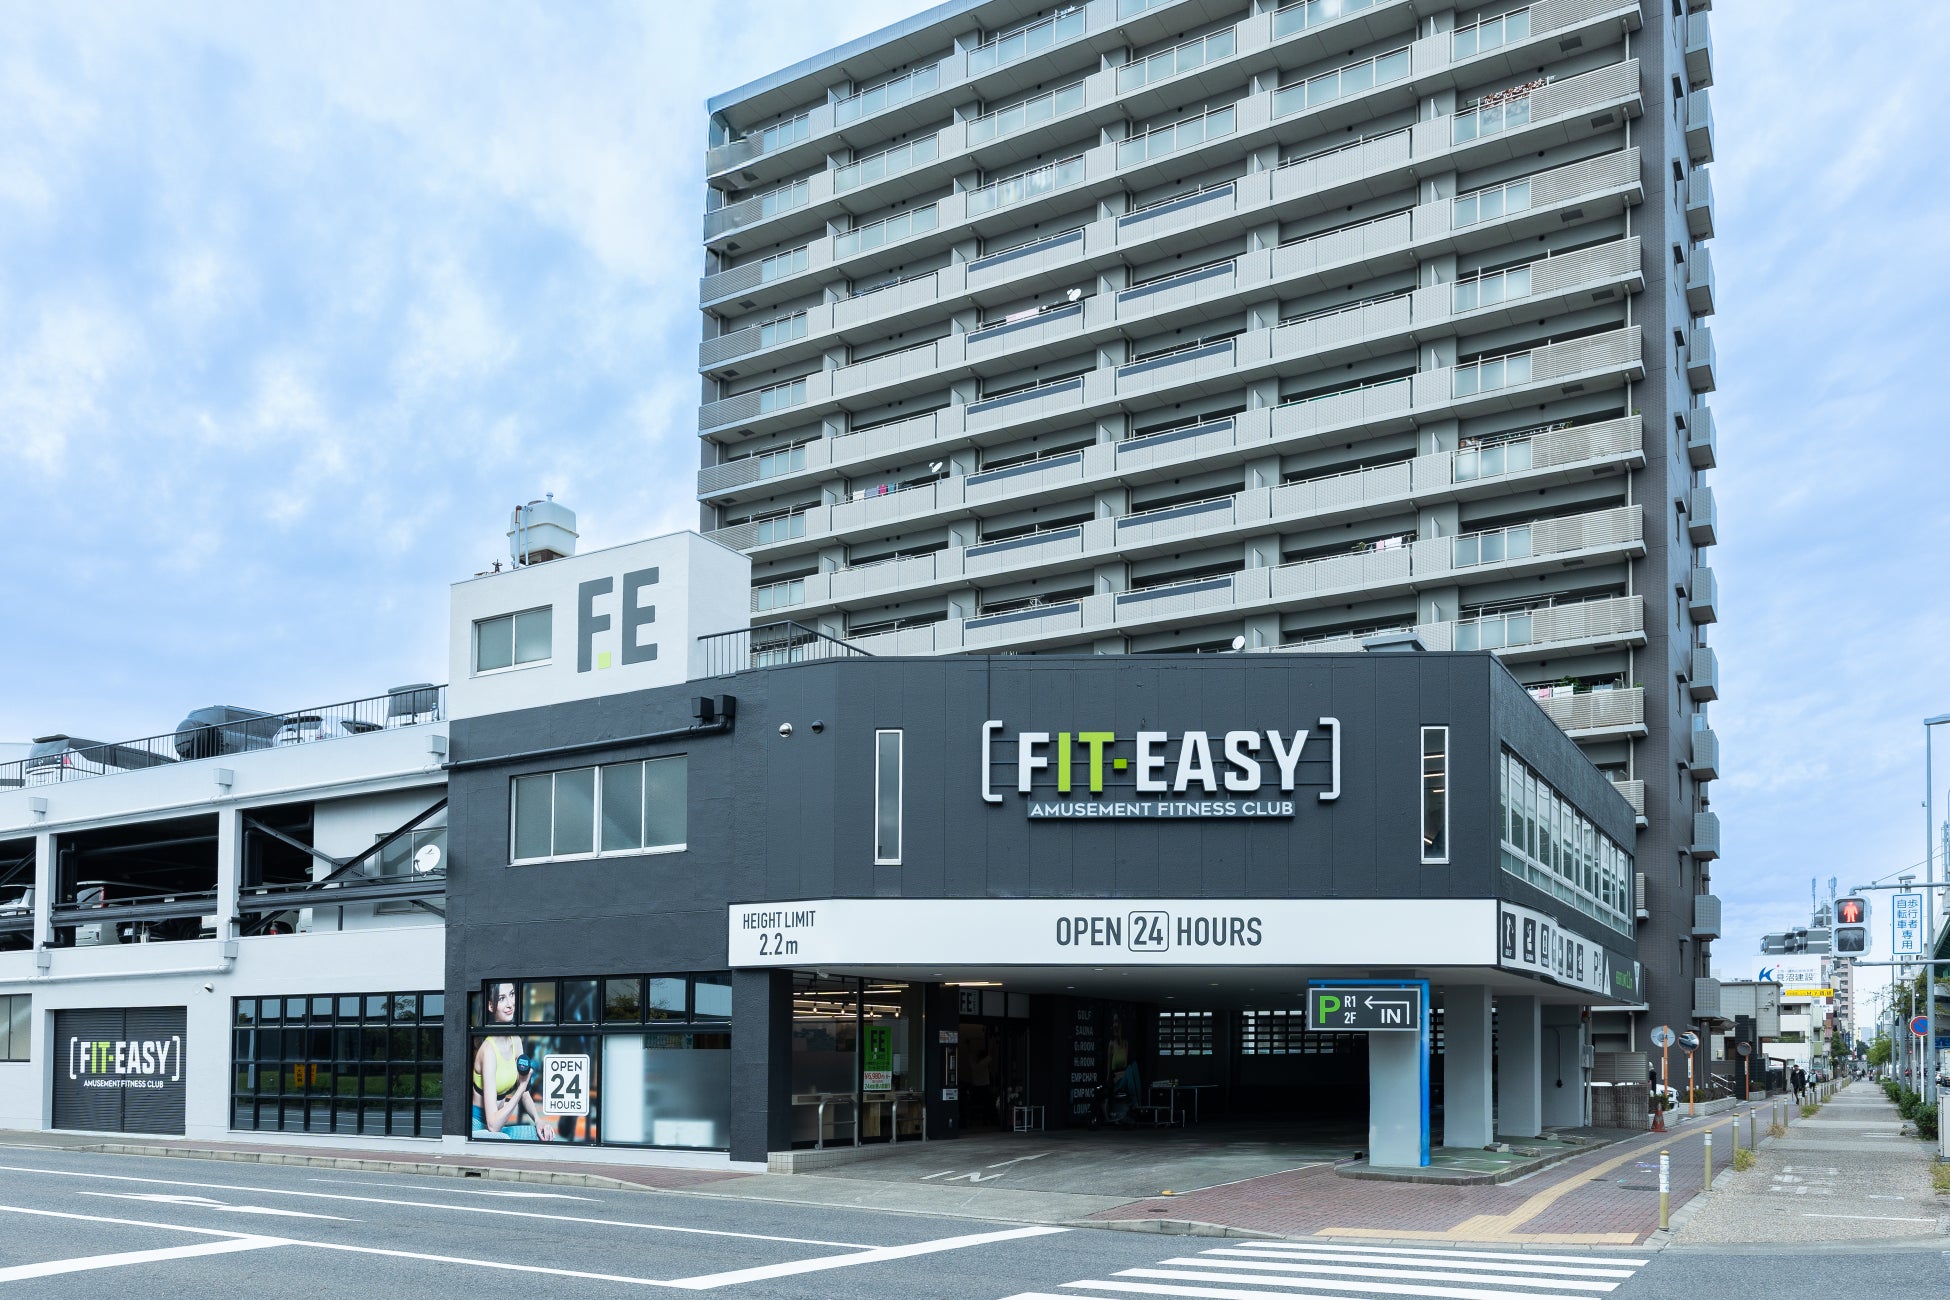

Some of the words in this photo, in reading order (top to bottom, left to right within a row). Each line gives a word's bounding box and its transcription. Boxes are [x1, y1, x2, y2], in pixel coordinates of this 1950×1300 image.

[1031, 802, 1152, 817] AMUSEMENT
[1158, 802, 1237, 816] FITNESS
[1241, 801, 1294, 816] CLUB
[742, 911, 783, 930] HEIGHT
[784, 910, 816, 929] LIMIT
[1056, 916, 1122, 947] OPEN
[1133, 916, 1164, 946] 24
[1177, 916, 1263, 947] HOURS
[1319, 995, 1341, 1024] P
[1344, 995, 1357, 1008] R1
[1344, 1012, 1357, 1024] 2F
[1381, 1008, 1401, 1024] IN
[550, 1060, 583, 1072] OPEN
[83, 1079, 120, 1088] AMUSEMENT
[121, 1080, 146, 1088] FITNESS
[147, 1080, 164, 1089] CLUB
[550, 1073, 582, 1099] 24
[549, 1100, 582, 1111] HOURS
